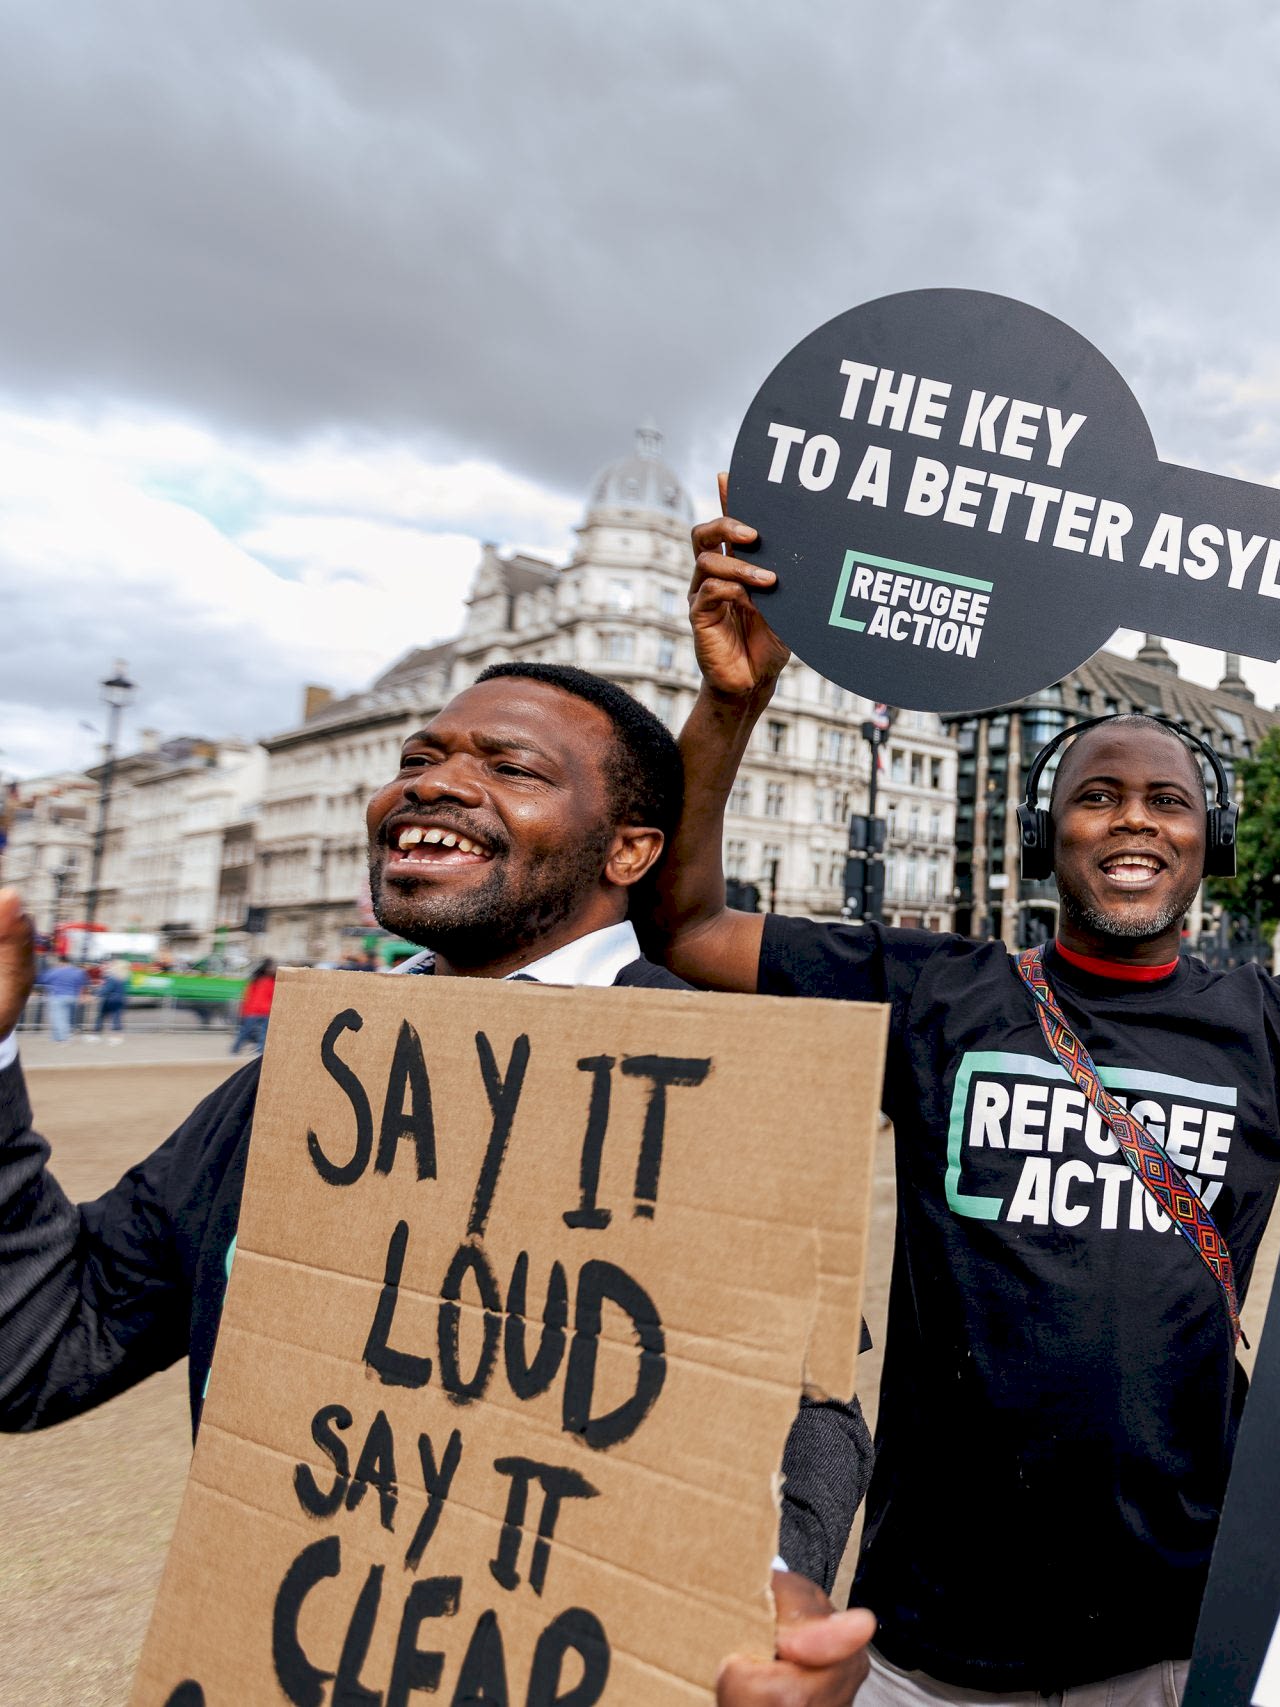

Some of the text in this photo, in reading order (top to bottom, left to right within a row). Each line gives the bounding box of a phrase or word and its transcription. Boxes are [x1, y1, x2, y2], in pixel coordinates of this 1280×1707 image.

[839, 358, 1088, 469] THE KEY
[766, 422, 841, 492] TO
[846, 444, 893, 508] A
[904, 455, 1134, 563] BETTER
[850, 566, 991, 626] REFUGEE
[867, 606, 983, 659] ACTION
[307, 1008, 714, 1240] SAY IT
[363, 1220, 667, 1450] LOUD
[293, 1404, 601, 1596] SAY IT
